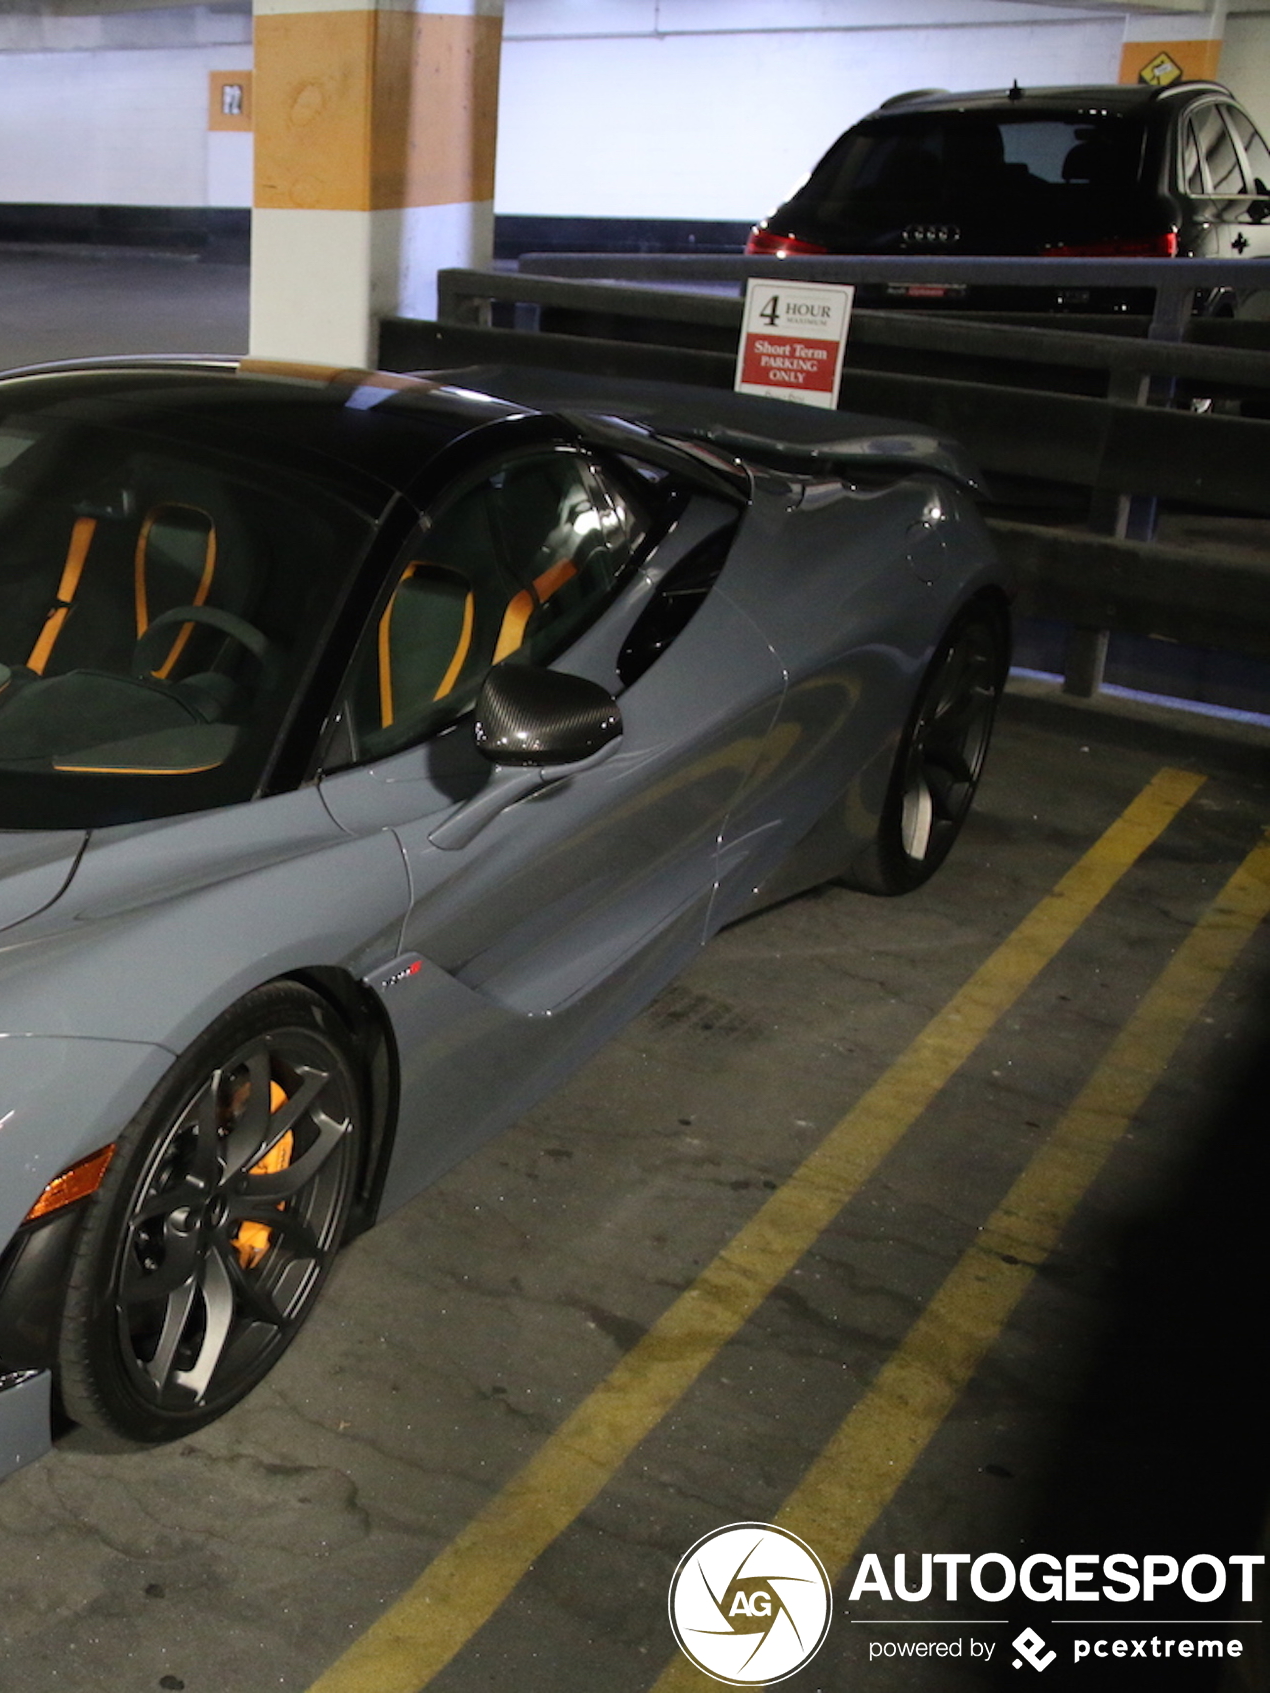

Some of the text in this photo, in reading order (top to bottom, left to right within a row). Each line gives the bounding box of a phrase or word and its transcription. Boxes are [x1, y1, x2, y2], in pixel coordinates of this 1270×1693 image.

[759, 295, 831, 327] 4 HOUR
[787, 317, 827, 326] MAXIMUM
[754, 340, 827, 360] Short Term
[760, 356, 818, 371] PARKING
[768, 370, 806, 383] ONLY
